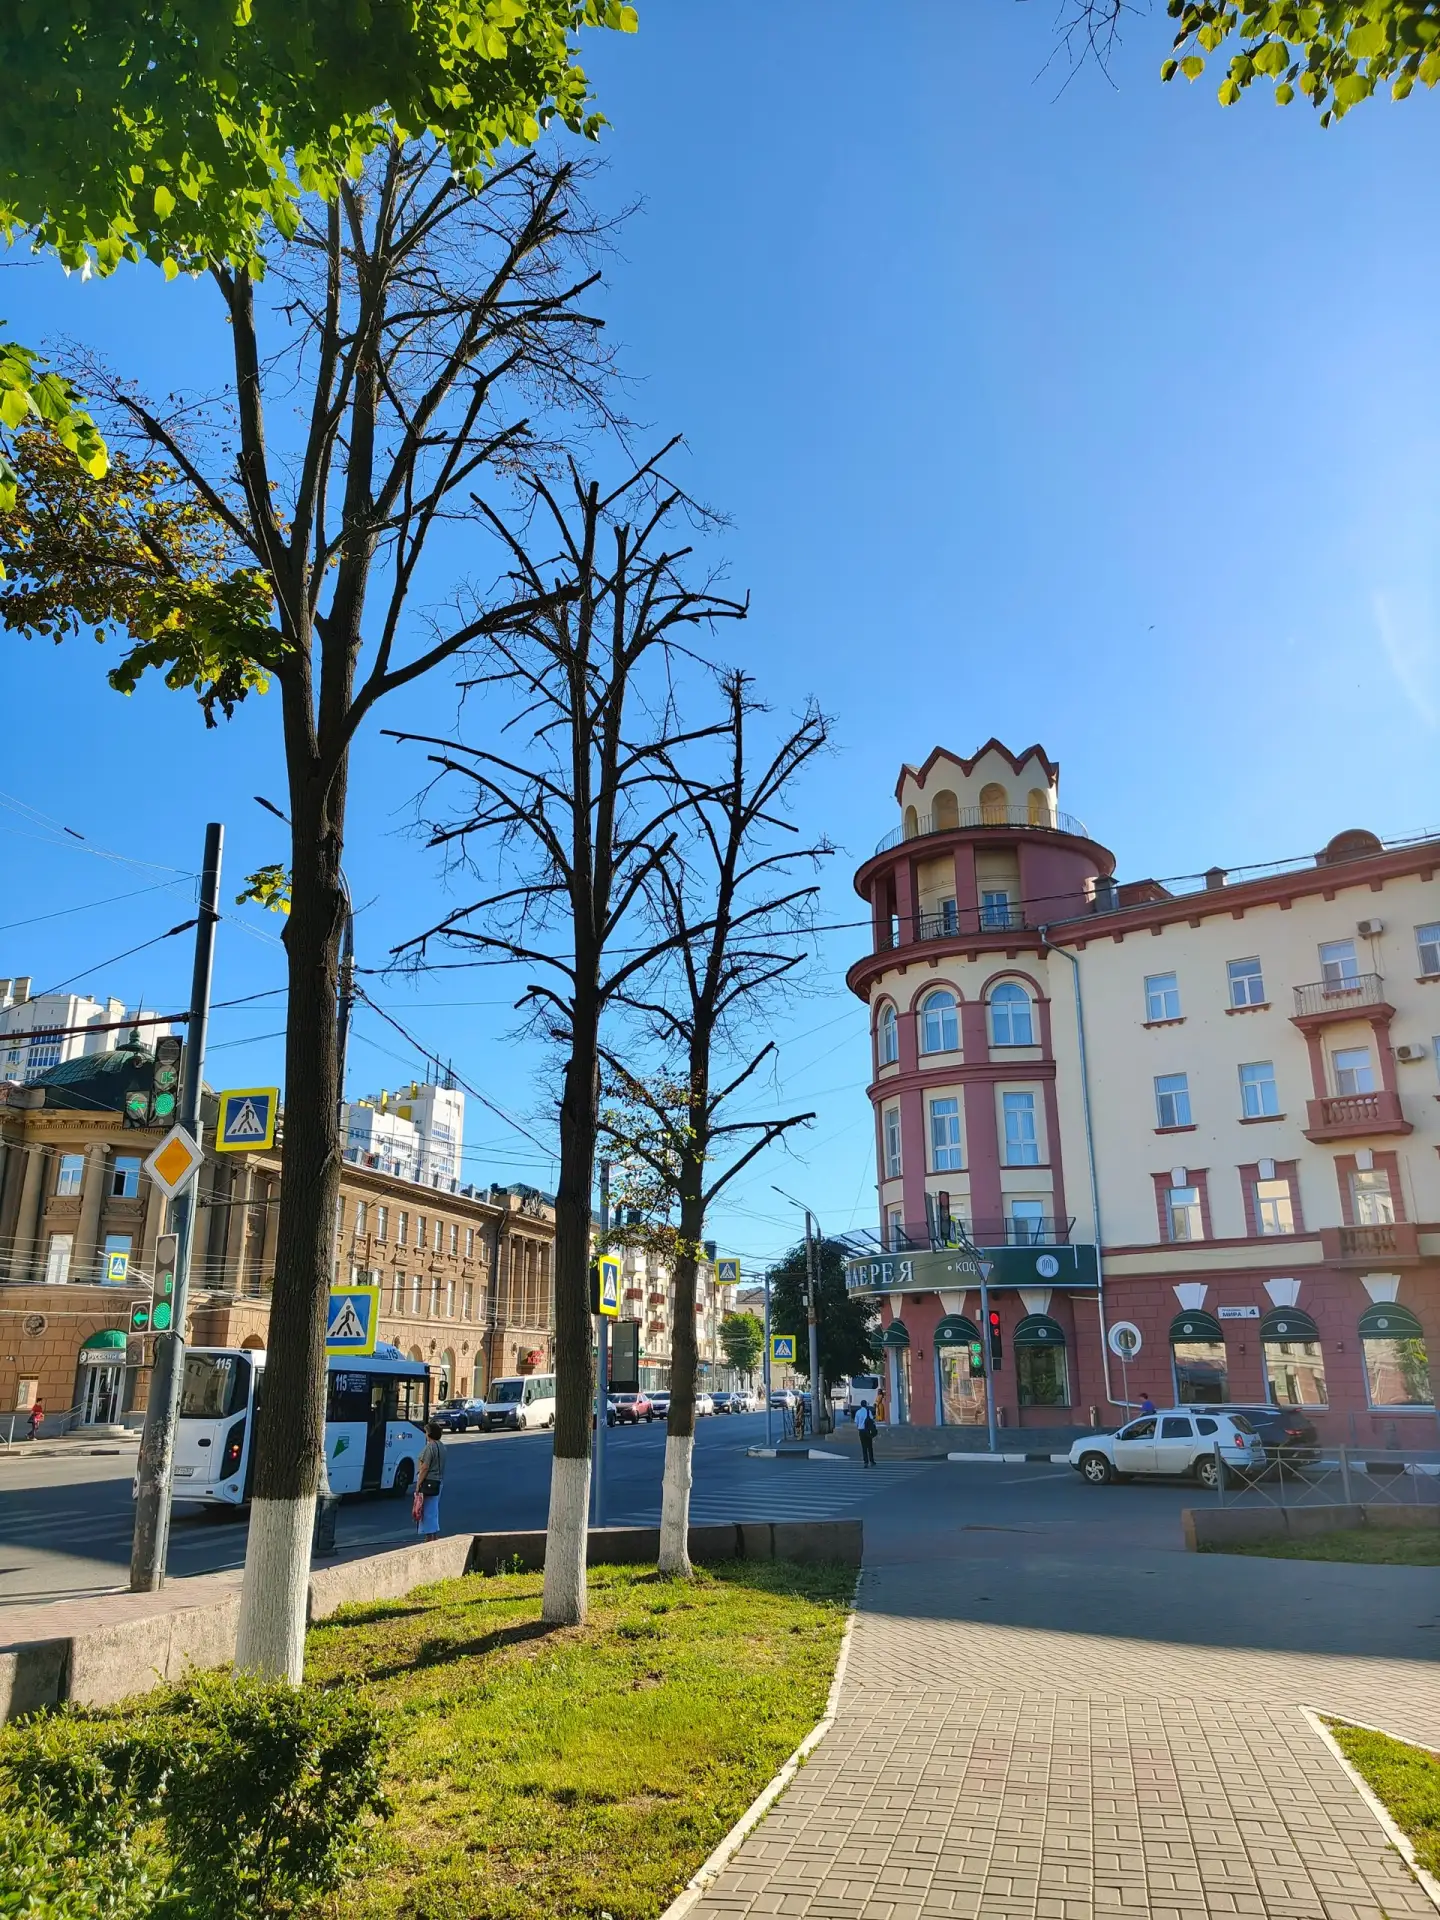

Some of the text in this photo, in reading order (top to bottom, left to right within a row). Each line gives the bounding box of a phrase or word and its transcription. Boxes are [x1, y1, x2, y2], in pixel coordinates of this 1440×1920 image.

[1249, 1308, 1257, 1316] 4
[386, 1347, 399, 1360] 115
[215, 1357, 232, 1370] 115
[335, 1373, 348, 1392] 115
